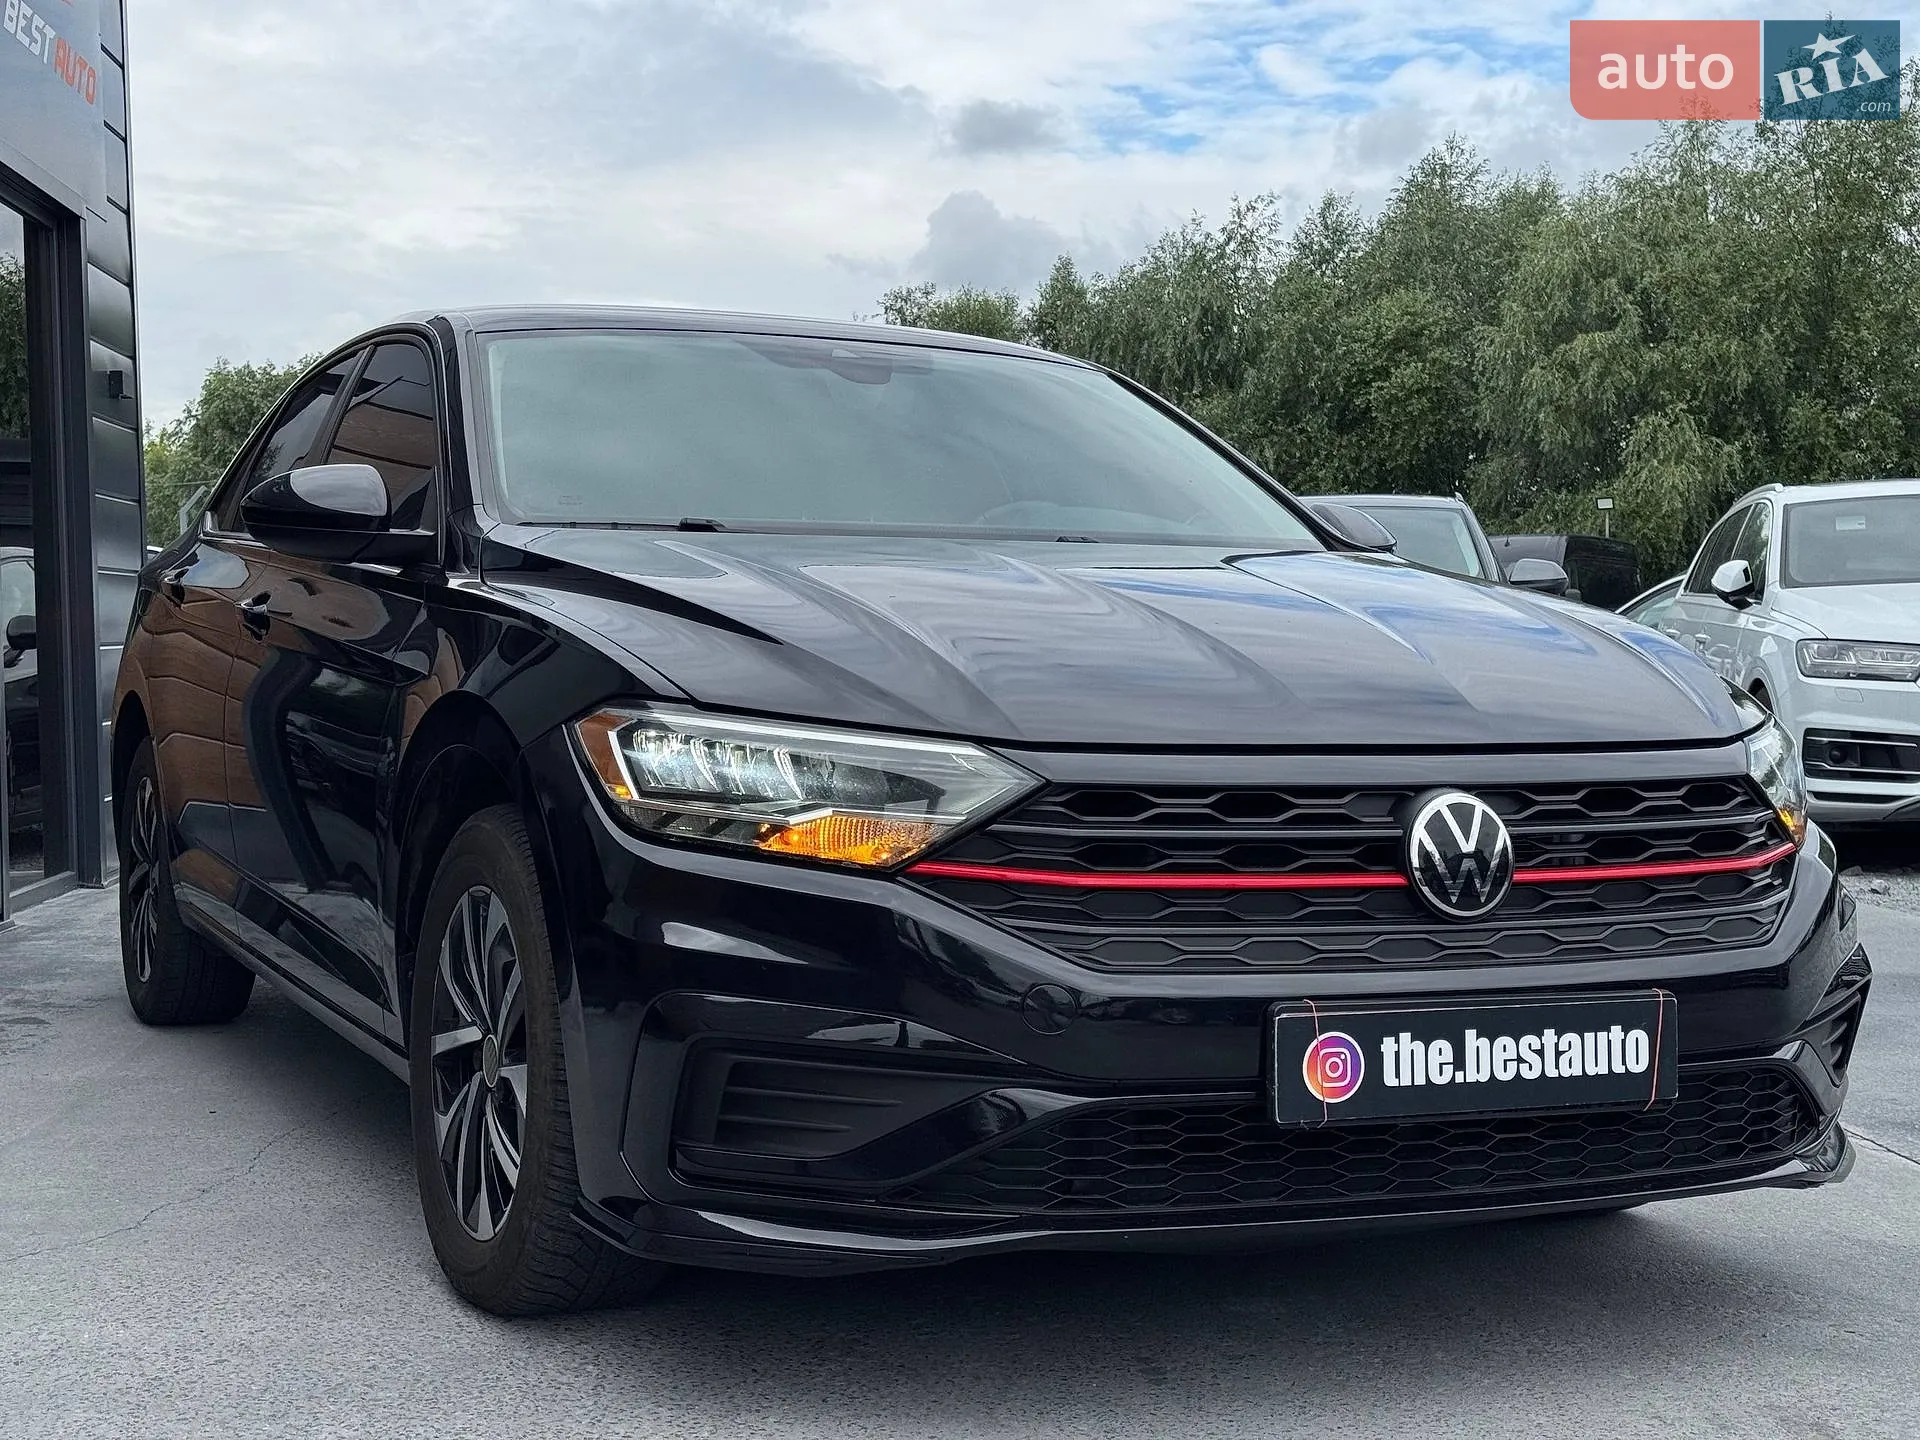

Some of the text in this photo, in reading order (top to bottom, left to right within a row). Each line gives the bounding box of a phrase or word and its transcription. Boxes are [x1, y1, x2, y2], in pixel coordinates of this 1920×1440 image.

[3, 0, 96, 105] BEST AUTO
[1381, 1025, 1649, 1086] the.bestauto
